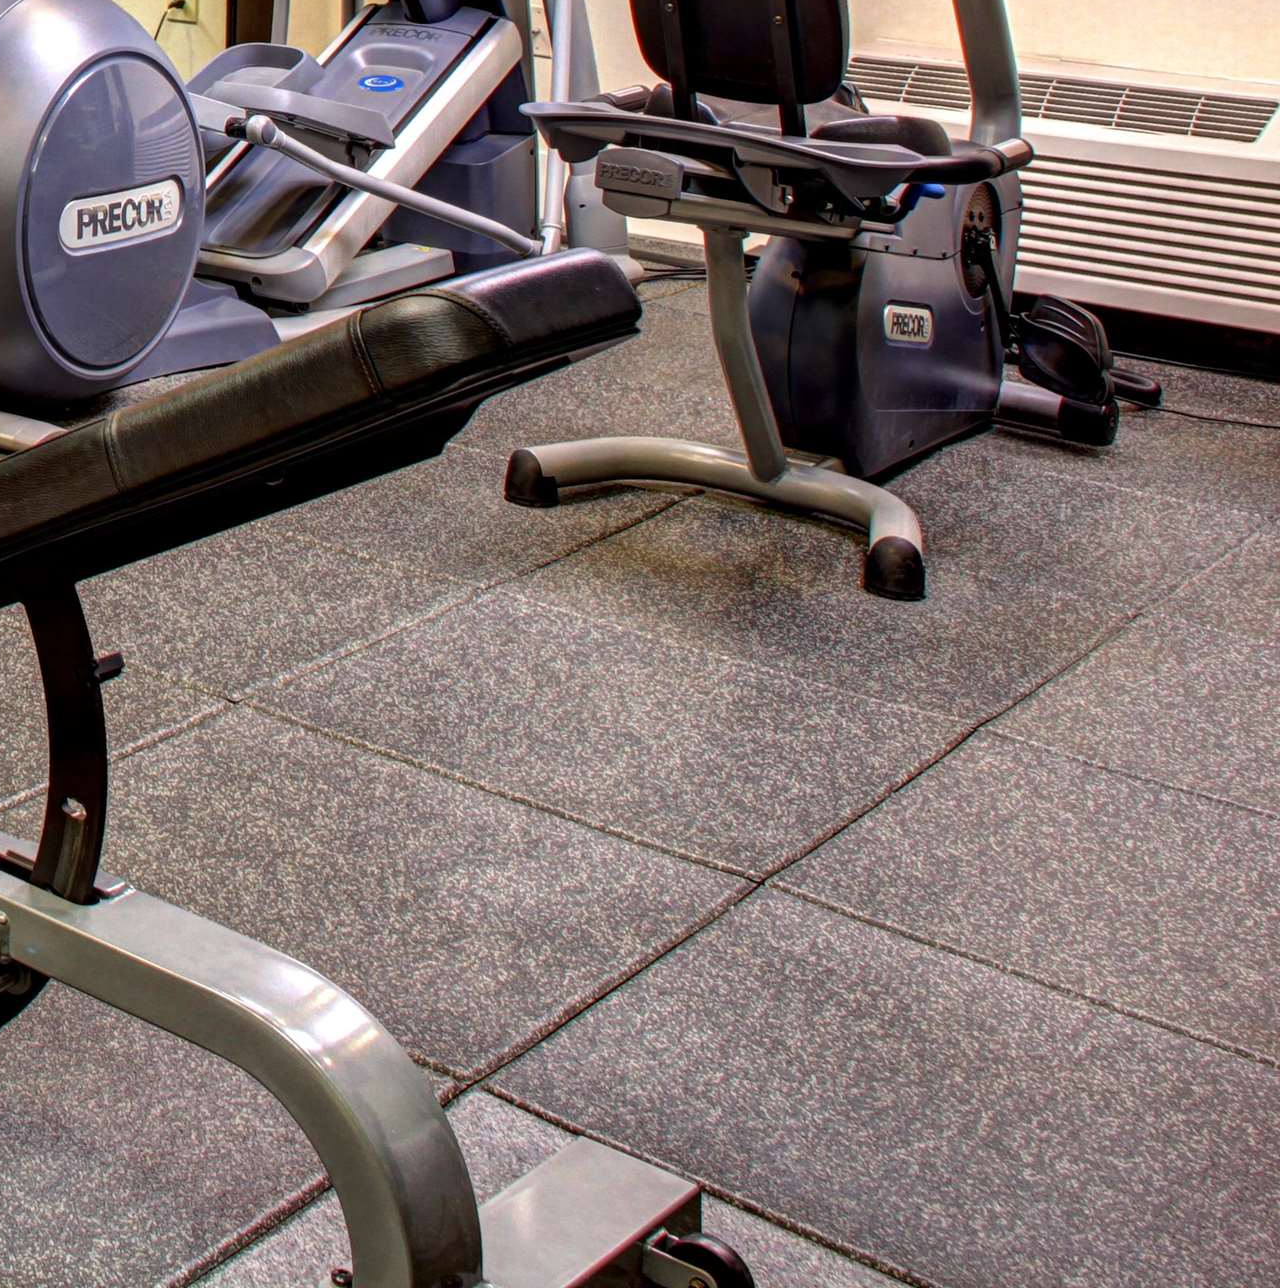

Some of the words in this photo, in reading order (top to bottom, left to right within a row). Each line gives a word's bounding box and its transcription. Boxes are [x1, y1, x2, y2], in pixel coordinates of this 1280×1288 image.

[598, 161, 665, 186] PRECOR
[75, 193, 165, 240] PRECOR
[891, 311, 926, 338] PRECOR
